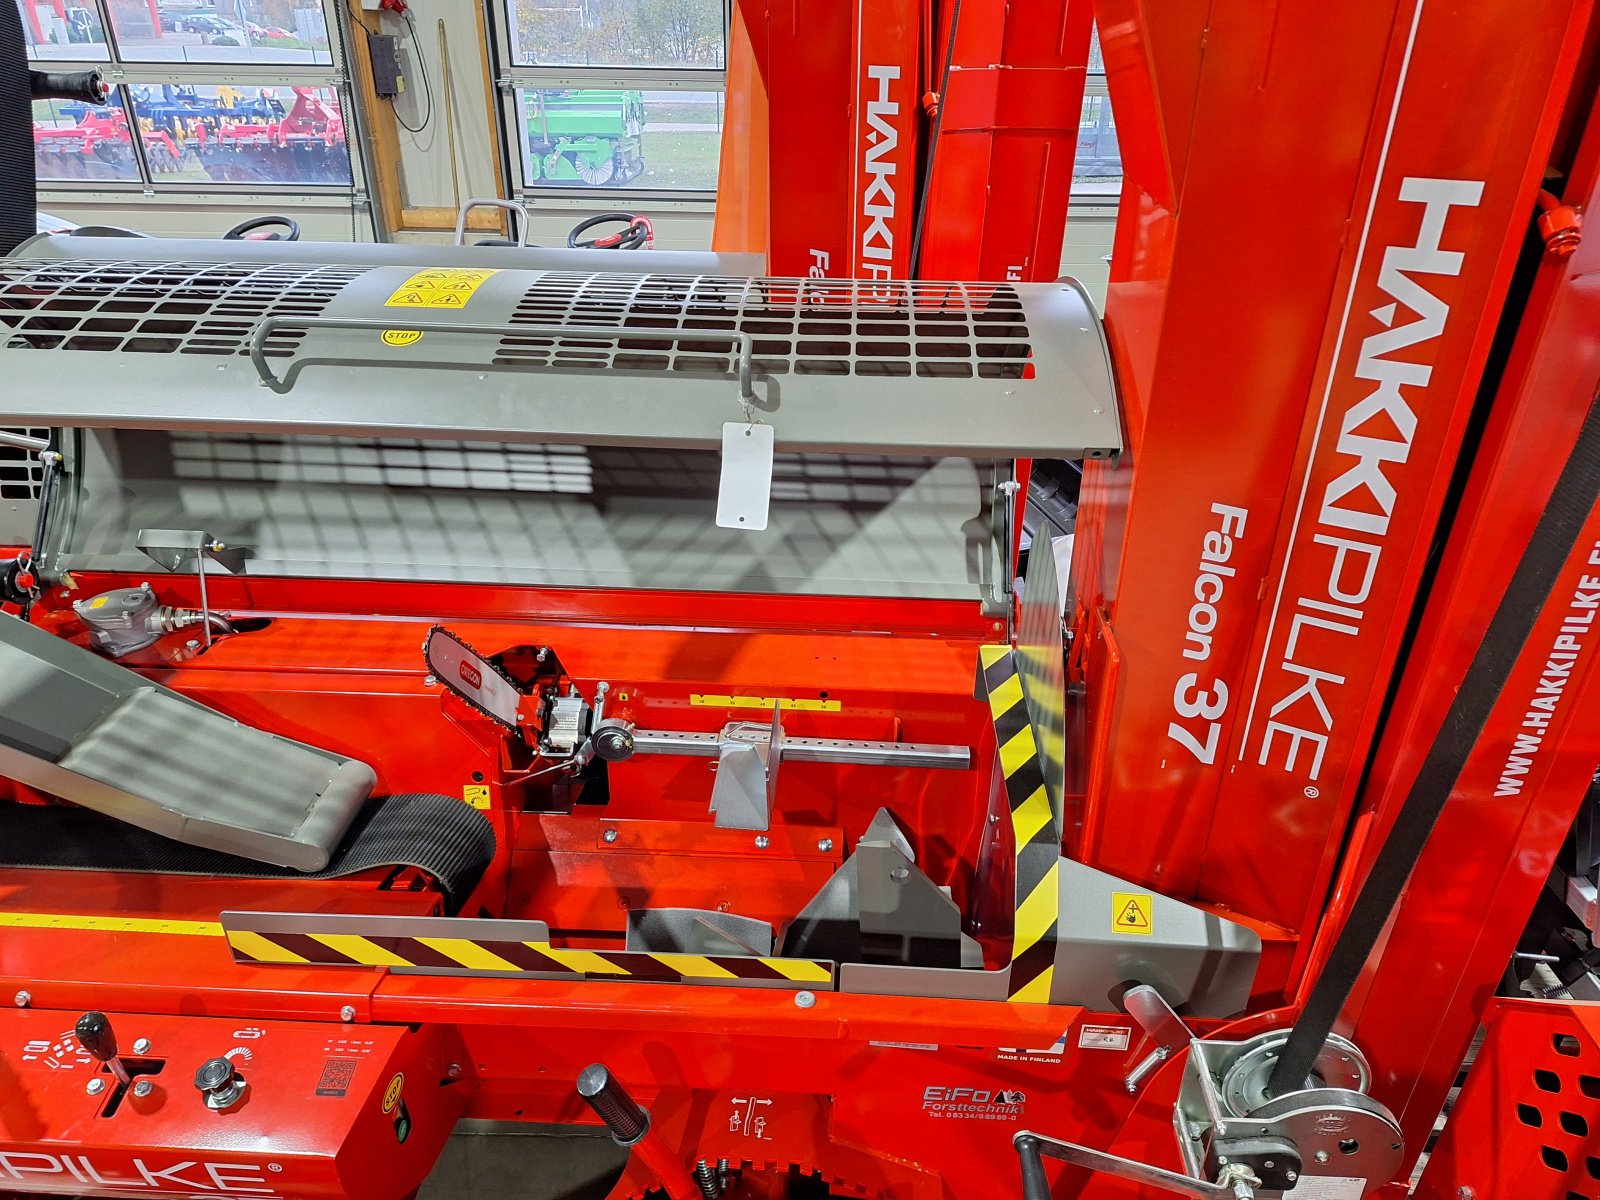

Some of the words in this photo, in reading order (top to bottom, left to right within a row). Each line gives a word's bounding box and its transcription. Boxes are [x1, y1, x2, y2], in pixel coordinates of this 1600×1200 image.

[1182, 502, 1249, 662] Falcon
[460, 664, 481, 687] OREGON
[1167, 673, 1230, 765] 37
[385, 1079, 401, 1106] STOP
[923, 1086, 991, 1102] EiFo
[922, 1101, 1018, 1115] Forsttechnik
